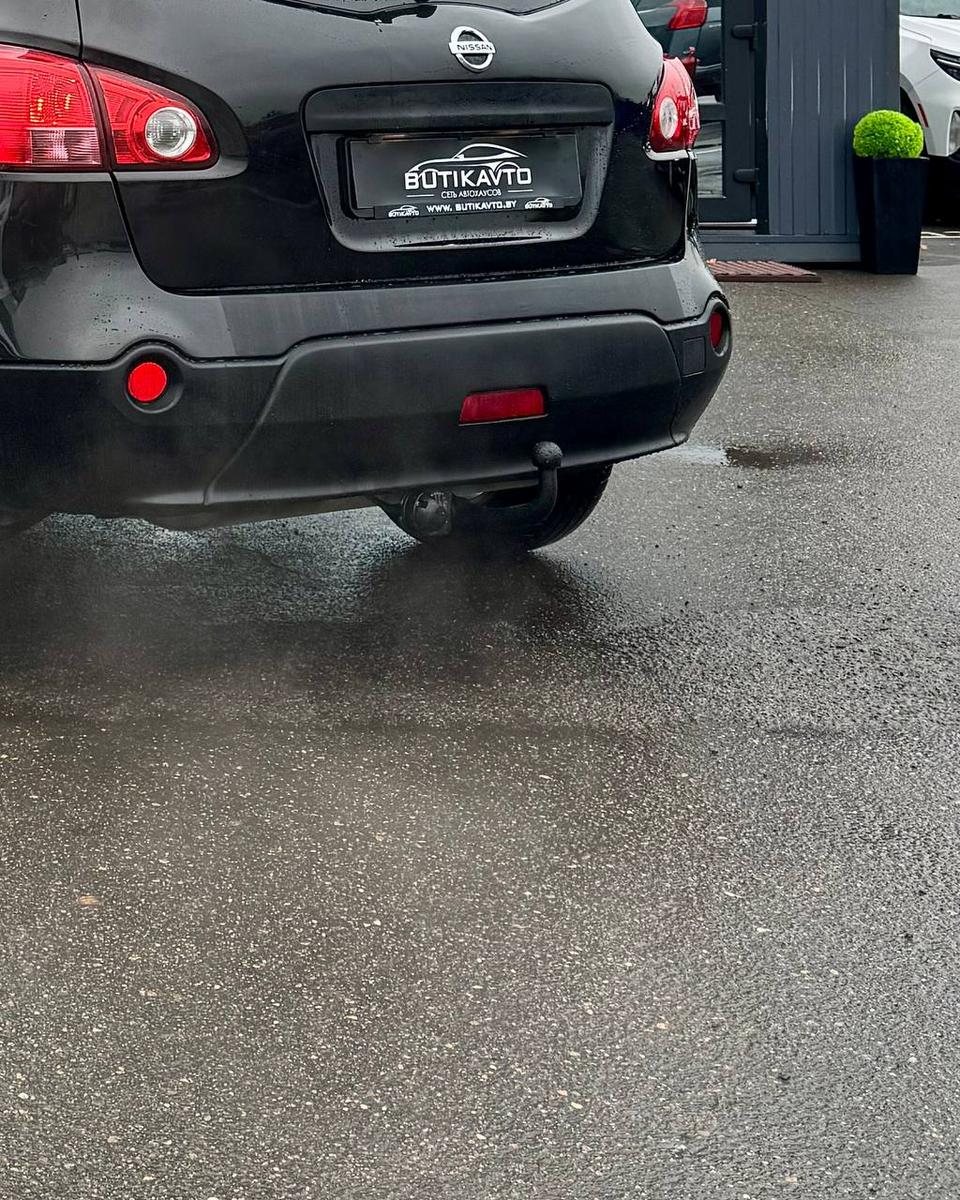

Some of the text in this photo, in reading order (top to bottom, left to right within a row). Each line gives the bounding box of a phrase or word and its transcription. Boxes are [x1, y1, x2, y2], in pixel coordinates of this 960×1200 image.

[456, 43, 493, 51] NISSAN
[404, 168, 532, 190] BUTIKAVTO
[441, 188, 502, 199] СЕТЬ АВТОХАУСОВ
[426, 200, 517, 213] WWW. BUTIKAVTO.BY
